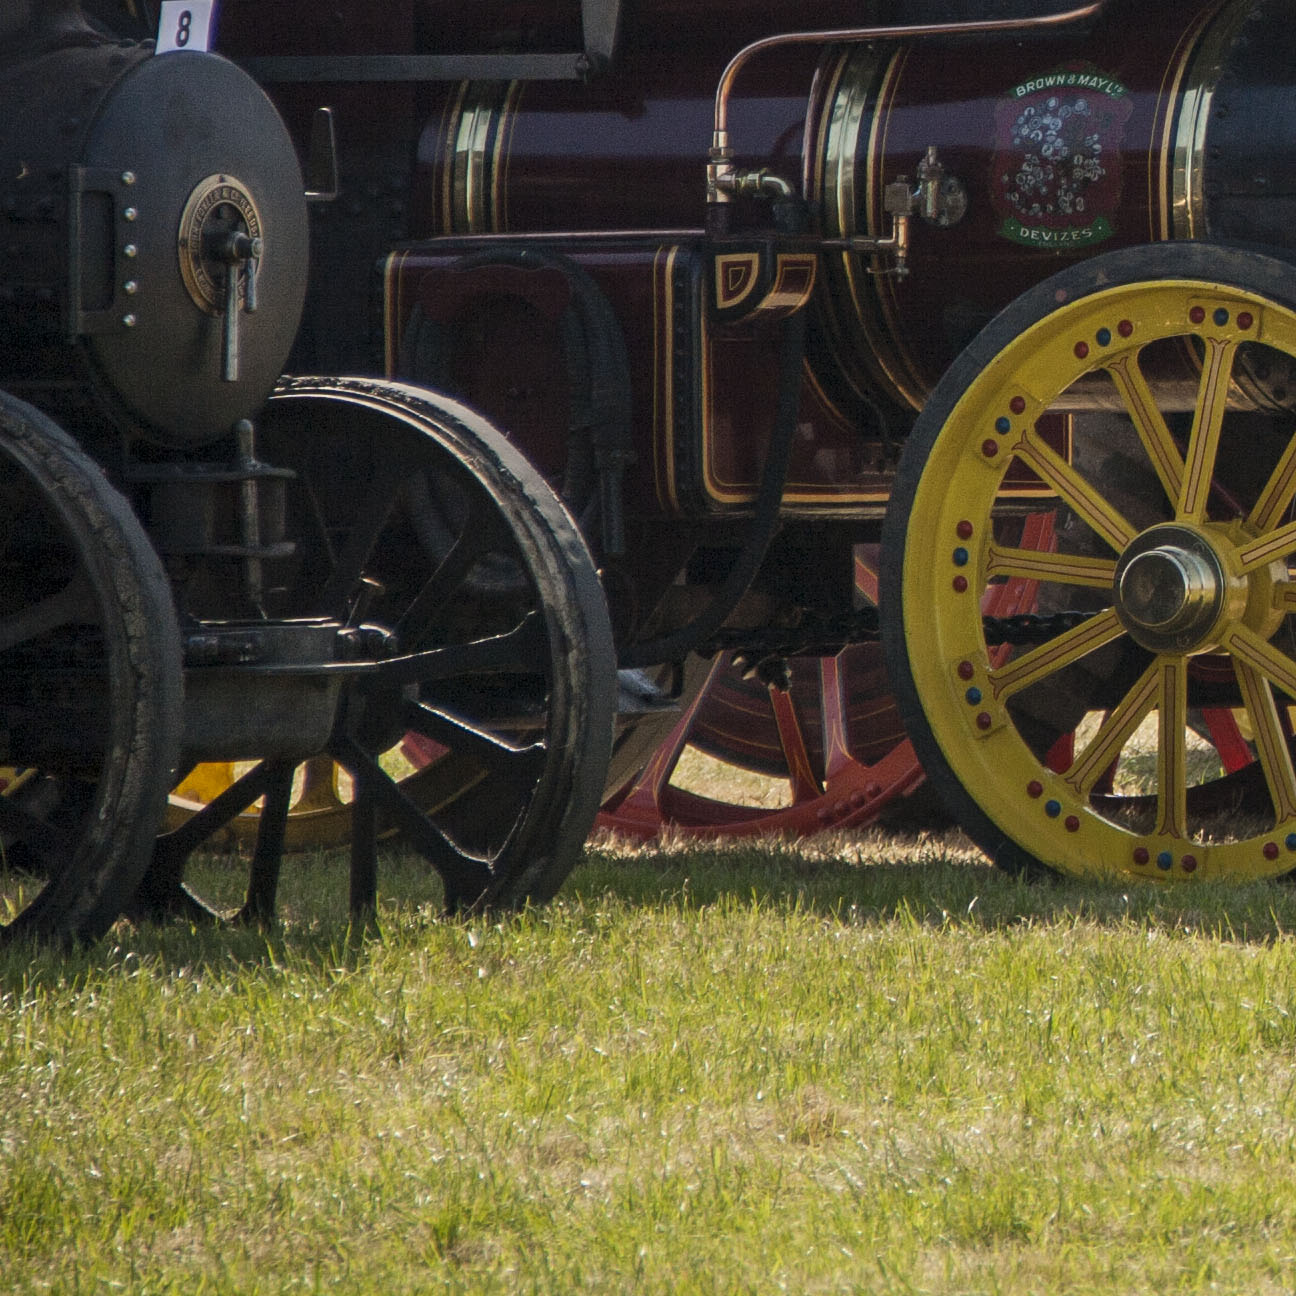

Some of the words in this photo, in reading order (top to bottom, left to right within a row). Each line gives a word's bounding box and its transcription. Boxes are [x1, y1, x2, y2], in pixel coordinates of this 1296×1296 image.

[175, 10, 192, 47] 8
[1015, 75, 1065, 97] BROWN
[1067, 74, 1076, 85] &
[1077, 74, 1108, 89] MAY
[1019, 227, 1093, 241] DEVIZES
